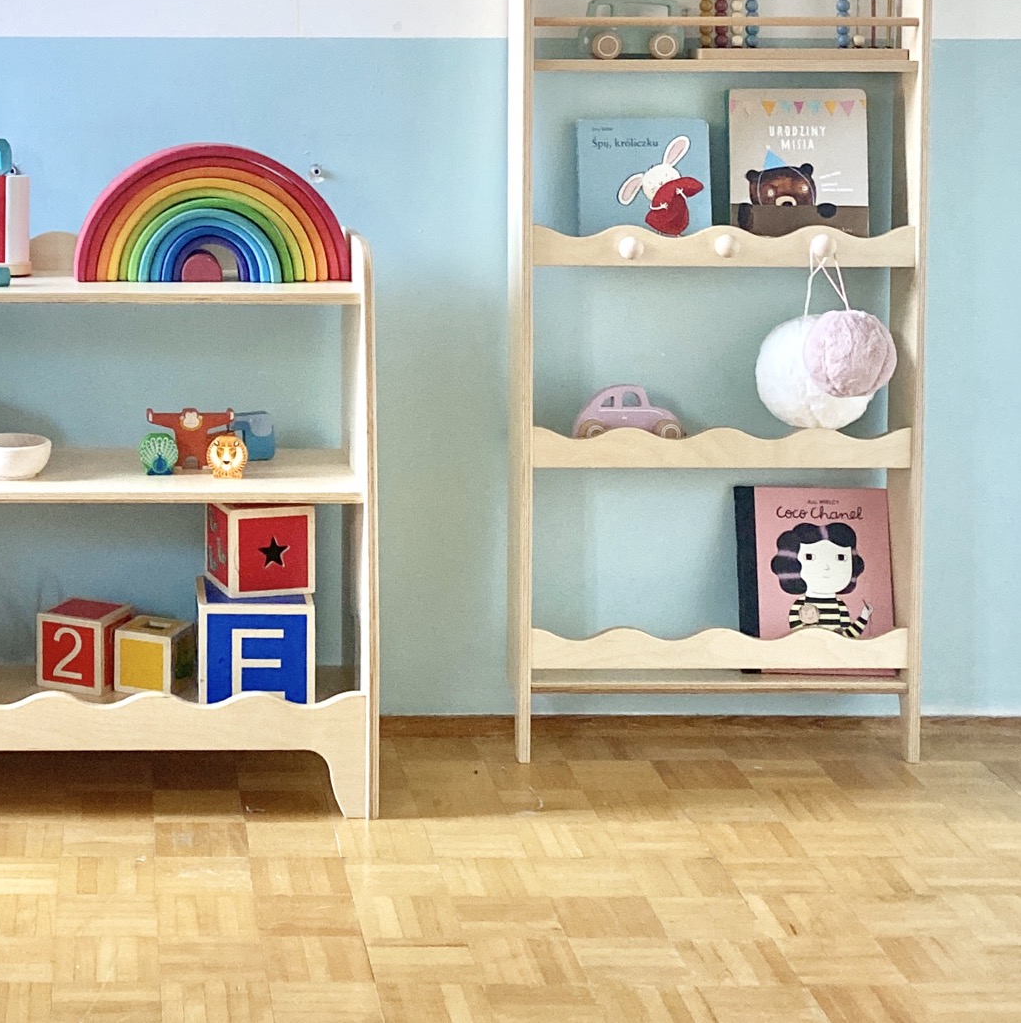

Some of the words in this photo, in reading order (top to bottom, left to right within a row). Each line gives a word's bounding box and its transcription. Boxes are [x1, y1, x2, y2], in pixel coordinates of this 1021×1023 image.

[768, 125, 826, 137] URODZINY
[614, 137, 659, 148] króliczku
[780, 139, 815, 150] MISIA
[776, 506, 808, 519] Coco
[810, 505, 864, 520] Chanel
[52, 626, 83, 681] 2
